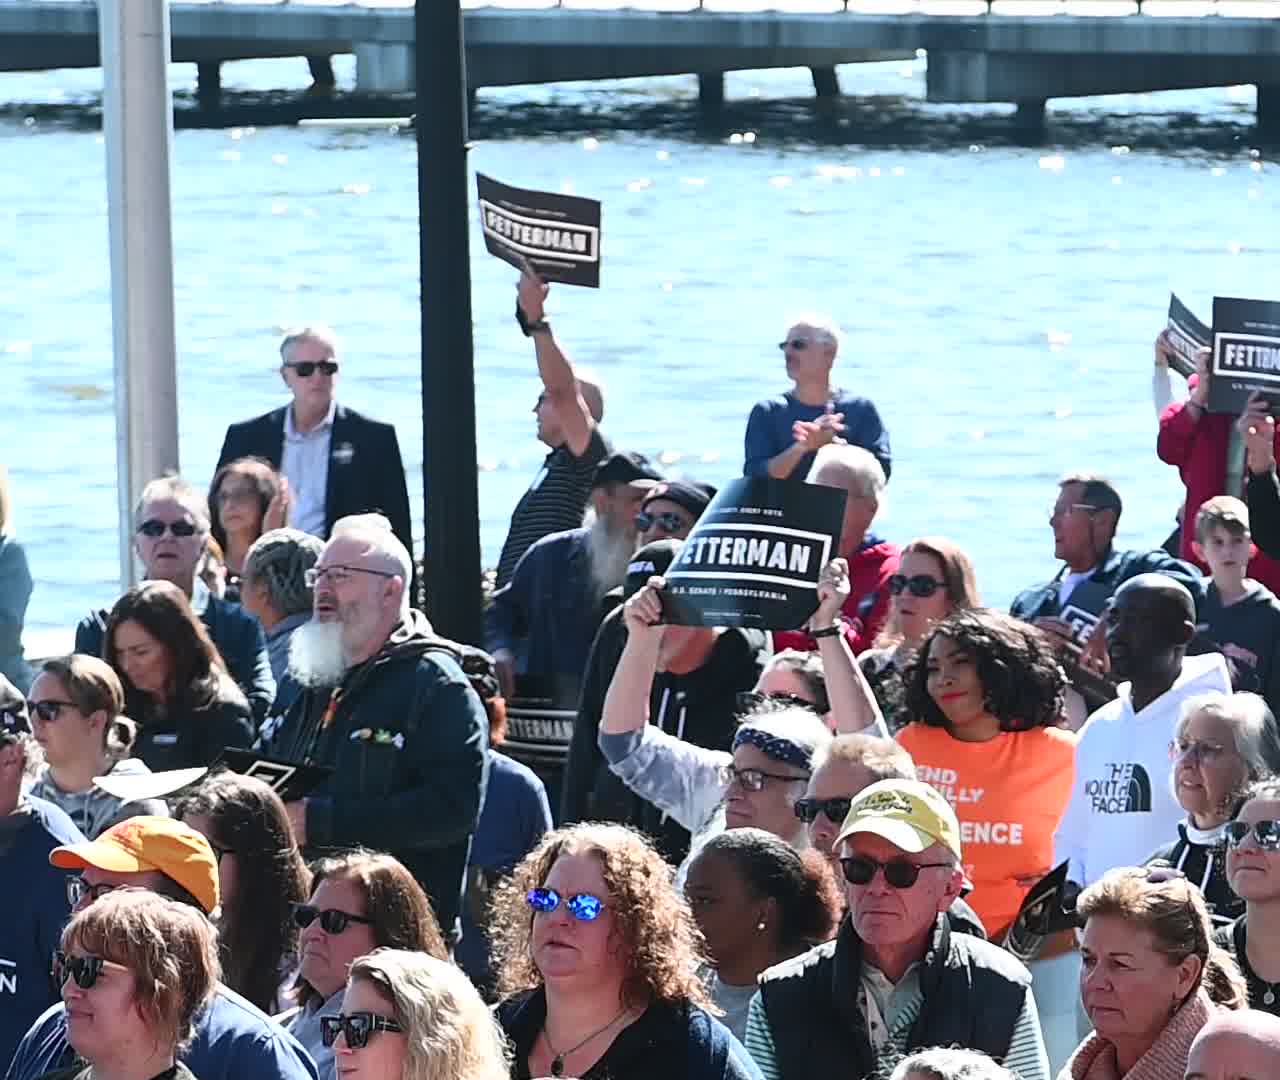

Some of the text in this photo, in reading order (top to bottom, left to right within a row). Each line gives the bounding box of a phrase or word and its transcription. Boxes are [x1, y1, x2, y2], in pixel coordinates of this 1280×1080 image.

[487, 211, 587, 252] FETTERMAN
[1092, 797, 1125, 814] FACE
[960, 821, 1023, 845] ENCE
